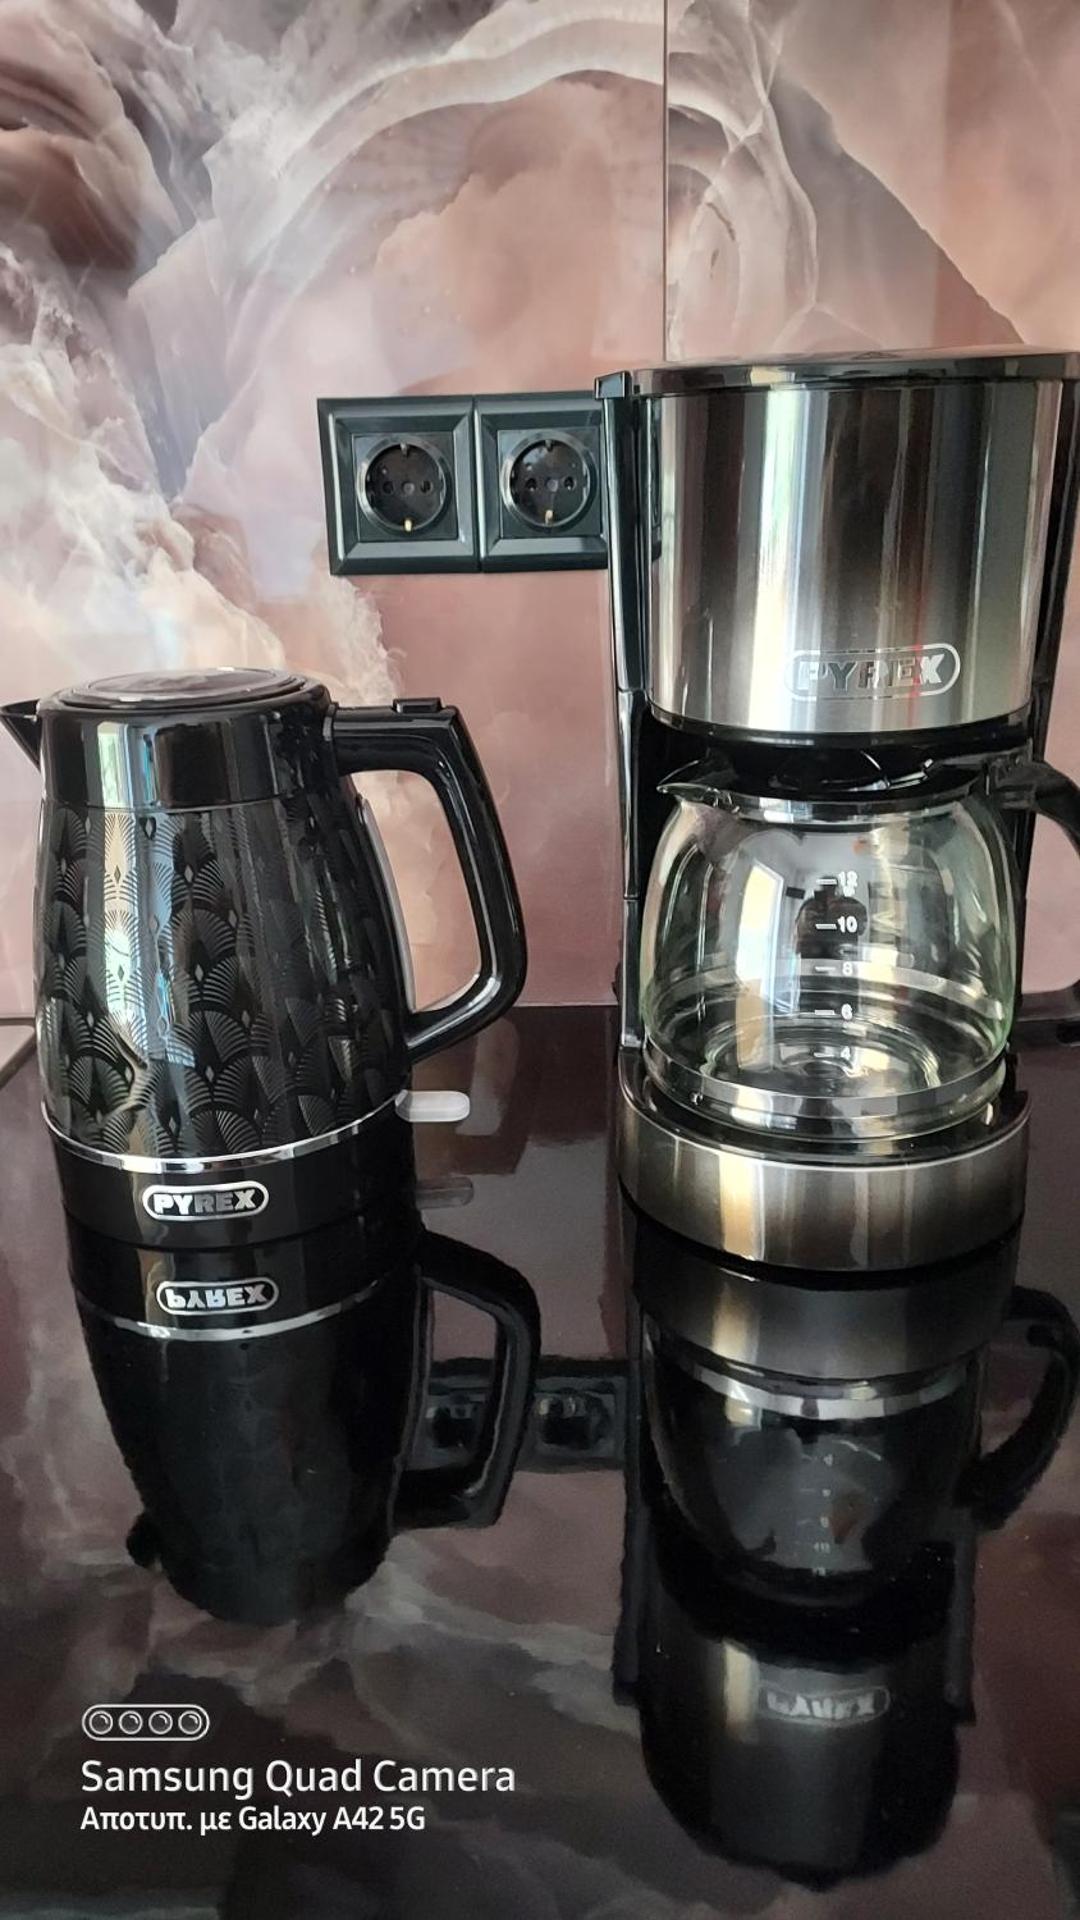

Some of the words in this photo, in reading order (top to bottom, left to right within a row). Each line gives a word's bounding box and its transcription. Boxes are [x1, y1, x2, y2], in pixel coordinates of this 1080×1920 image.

[795, 653, 946, 692] PYREX
[837, 915, 858, 933] 10
[842, 962, 853, 976] 8
[840, 1003, 853, 1020] 6
[152, 1188, 257, 1216] PYREX
